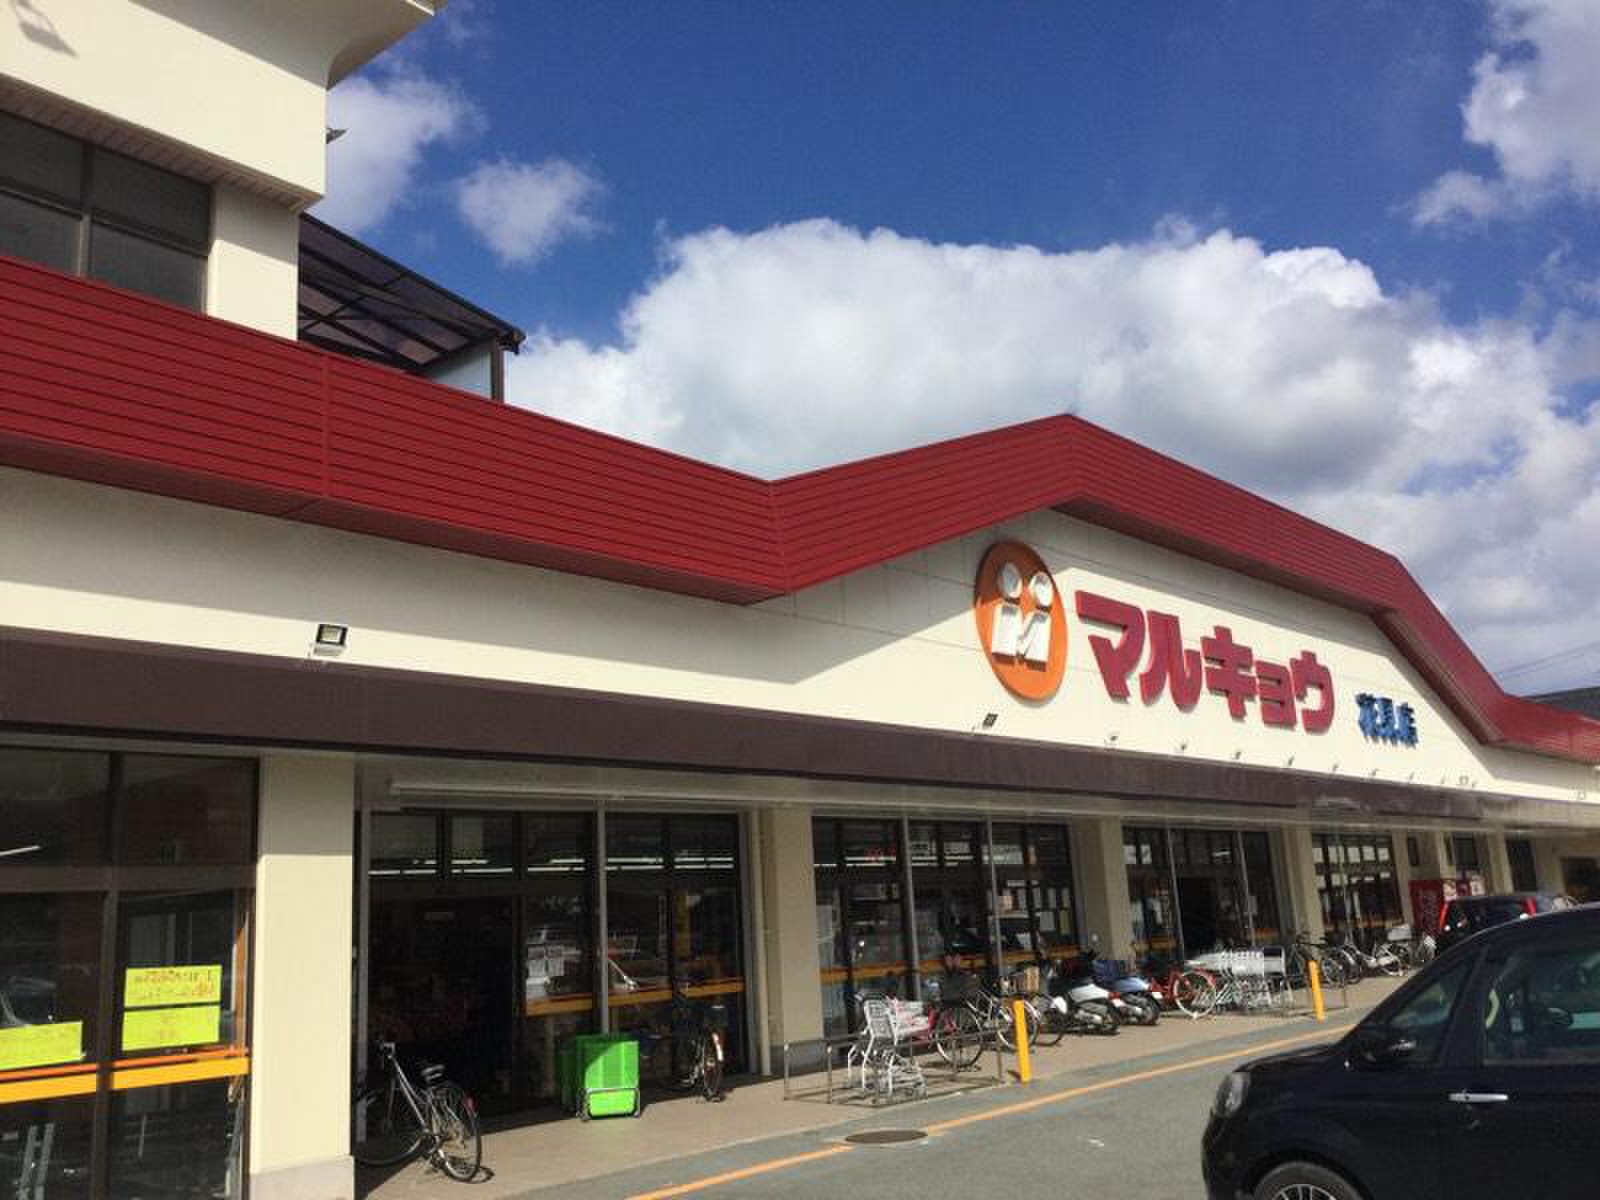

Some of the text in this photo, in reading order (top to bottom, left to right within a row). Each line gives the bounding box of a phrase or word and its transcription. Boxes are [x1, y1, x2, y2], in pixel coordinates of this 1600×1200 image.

[1075, 590, 1335, 733] マルキョウ
